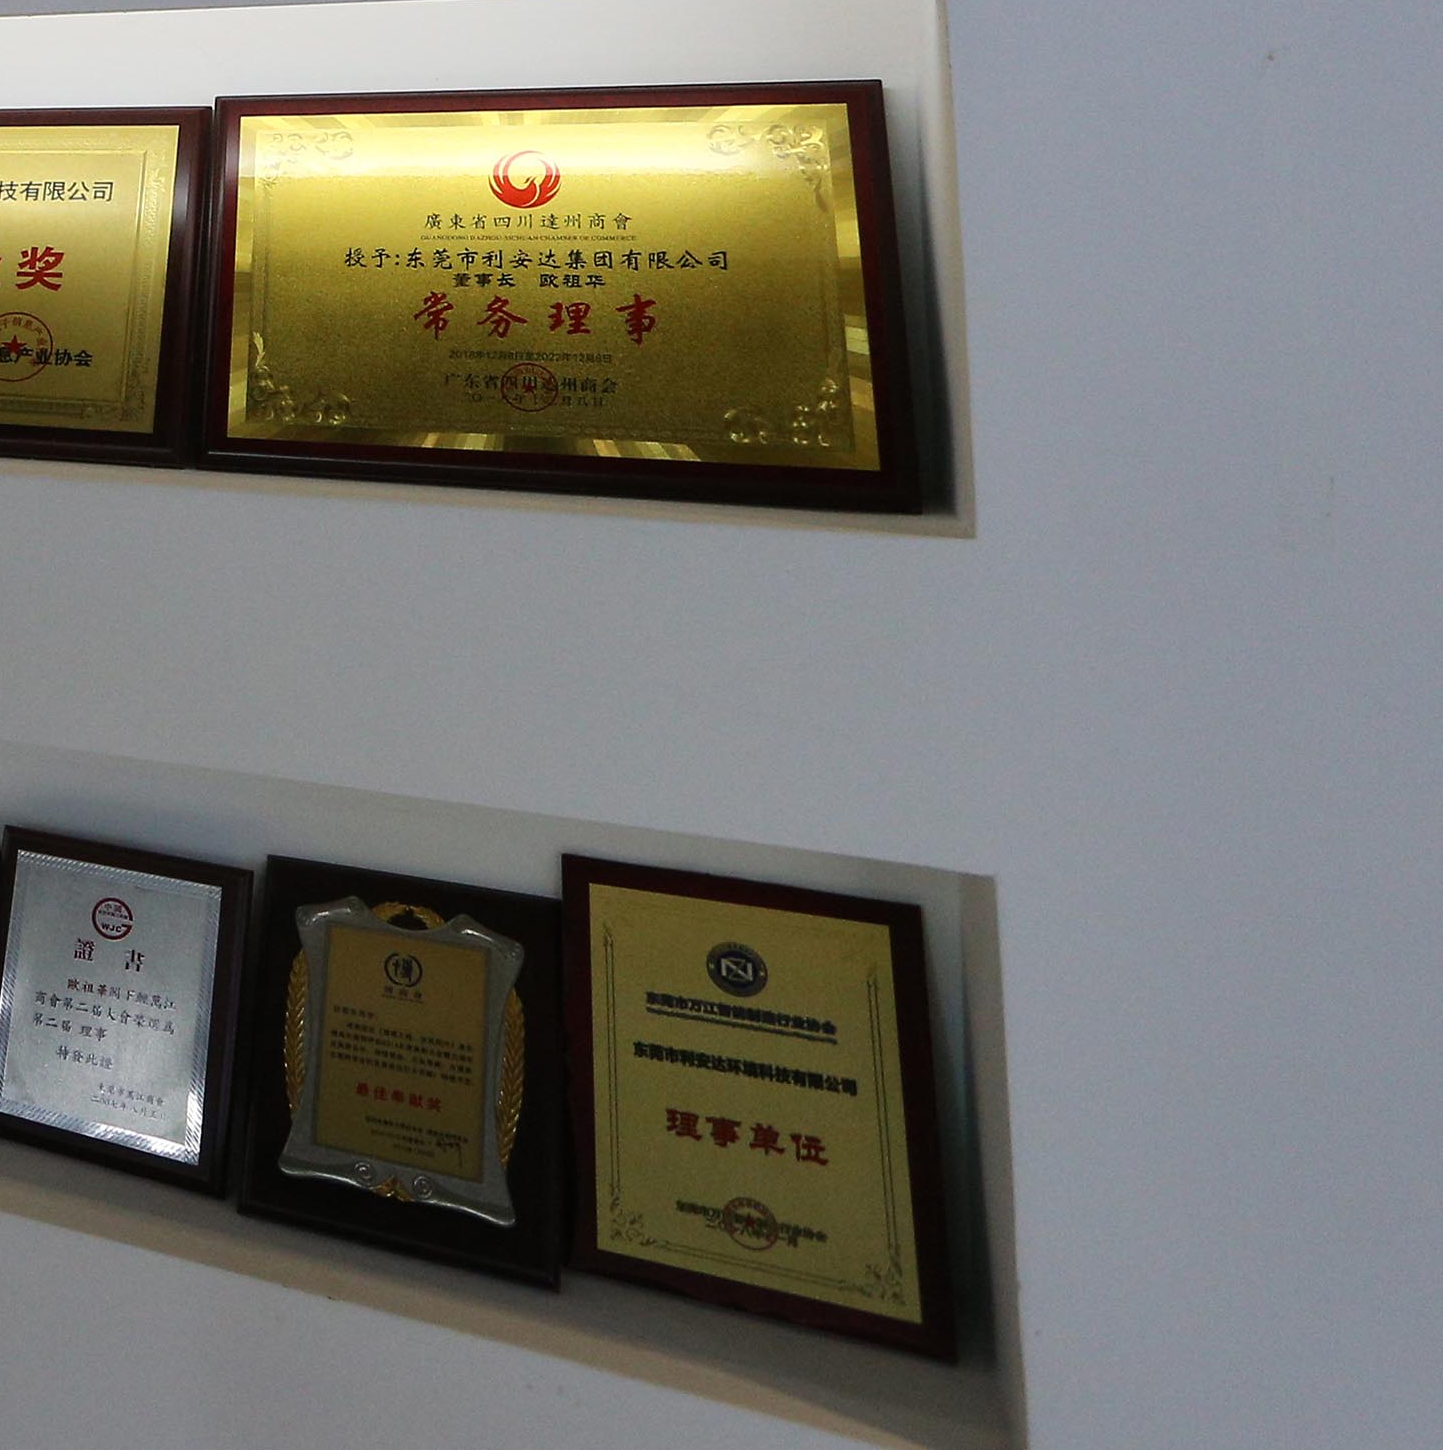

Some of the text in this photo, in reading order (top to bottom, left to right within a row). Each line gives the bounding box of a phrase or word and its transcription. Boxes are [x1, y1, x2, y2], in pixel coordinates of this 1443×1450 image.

[423, 211, 633, 232] 廣東省四川達州商會
[453, 272, 606, 288] 董事长 欧祖华
[413, 292, 660, 347] 常务理事
[631, 1039, 859, 1097] 东莞市利安达环境科技有限公司
[664, 1107, 830, 1167] 理事单位
